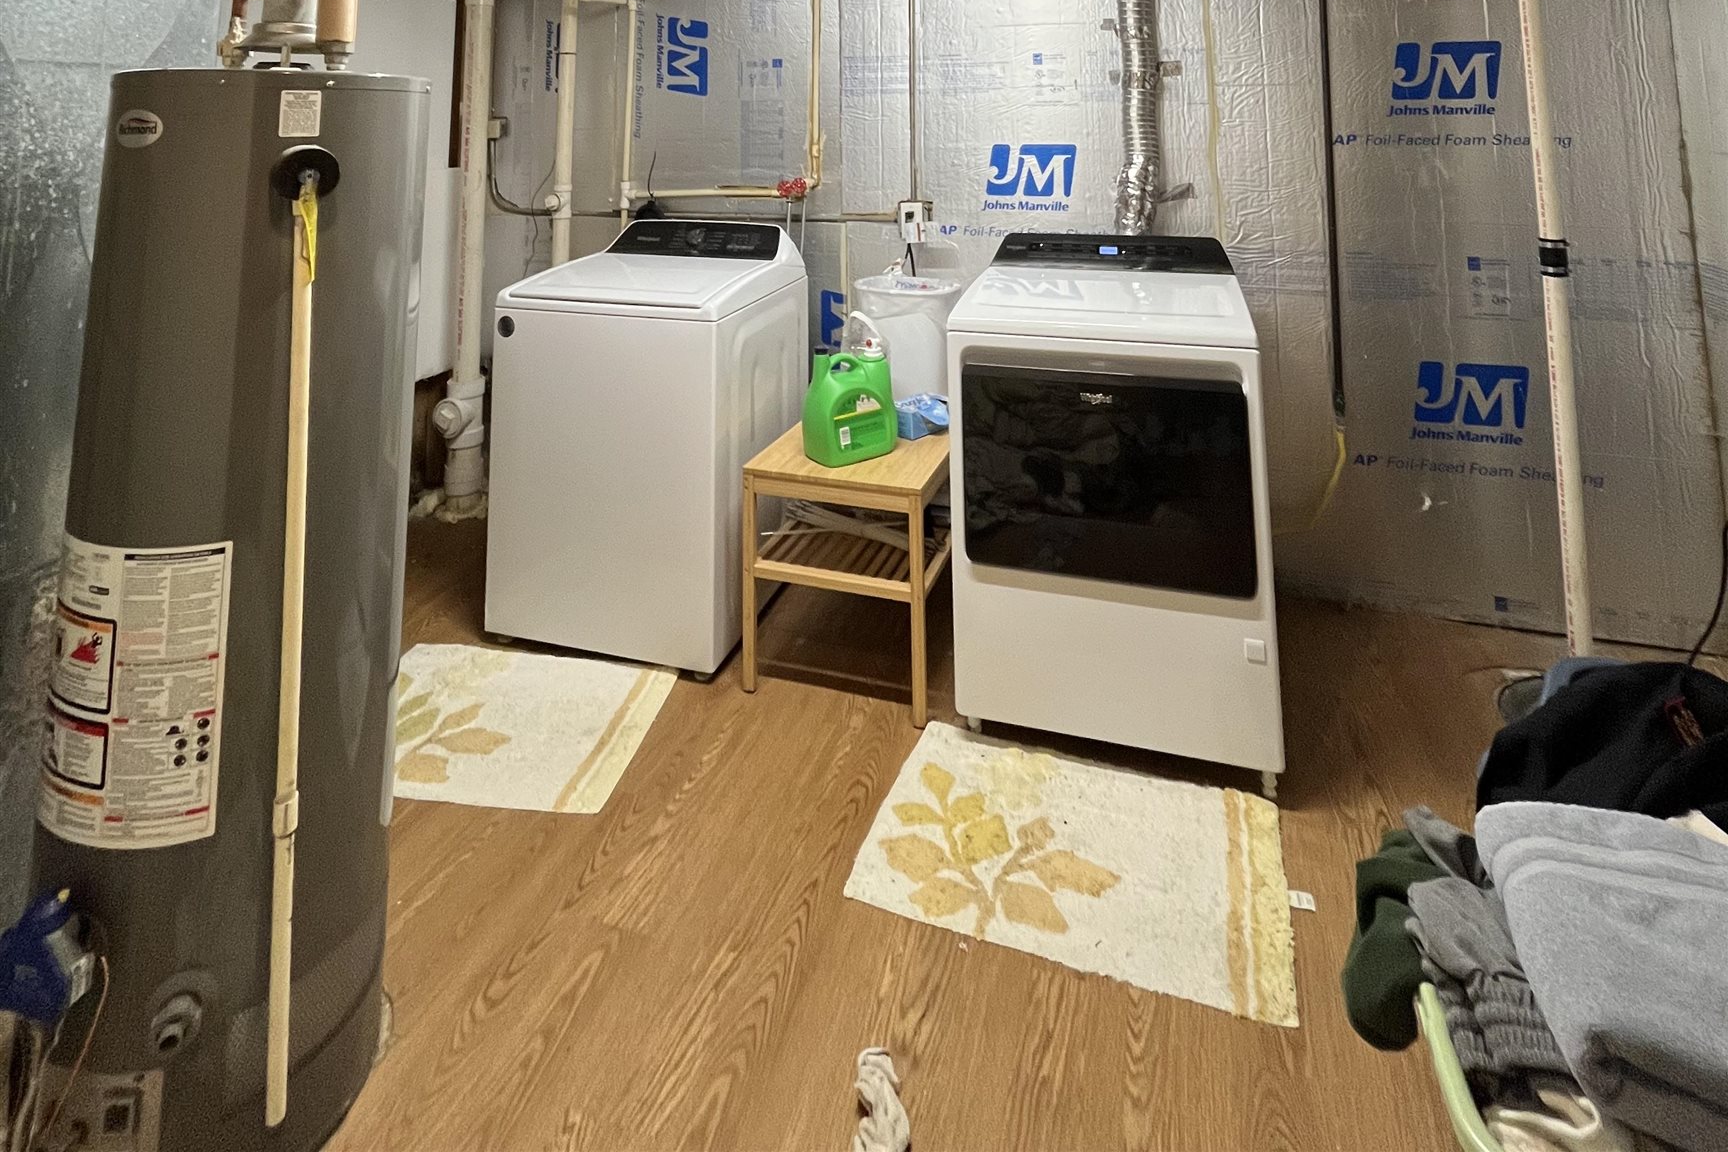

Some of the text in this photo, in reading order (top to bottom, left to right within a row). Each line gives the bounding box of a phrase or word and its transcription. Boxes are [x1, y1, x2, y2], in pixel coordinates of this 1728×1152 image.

[545, 19, 553, 91] Johns Manville
[635, 50, 645, 83] Foam
[656, 12, 665, 89] Johns Manville
[667, 16, 708, 96] JM
[1392, 40, 1502, 100] JM
[633, 85, 645, 139] Sheathing
[1387, 104, 1495, 117] Johns Manville
[1333, 134, 1358, 146] AP
[1365, 134, 1440, 146] Foil-Faced
[1445, 134, 1486, 146] Foam
[986, 144, 1077, 198] JM
[981, 200, 1069, 212] Johns Manville
[940, 225, 958, 236] AP
[1414, 361, 1529, 429] JM
[1409, 428, 1523, 446] Johns Manville
[1353, 454, 1378, 466] AP
[1387, 456, 1466, 474] Foil-Faced
[1470, 464, 1514, 478] Foam
